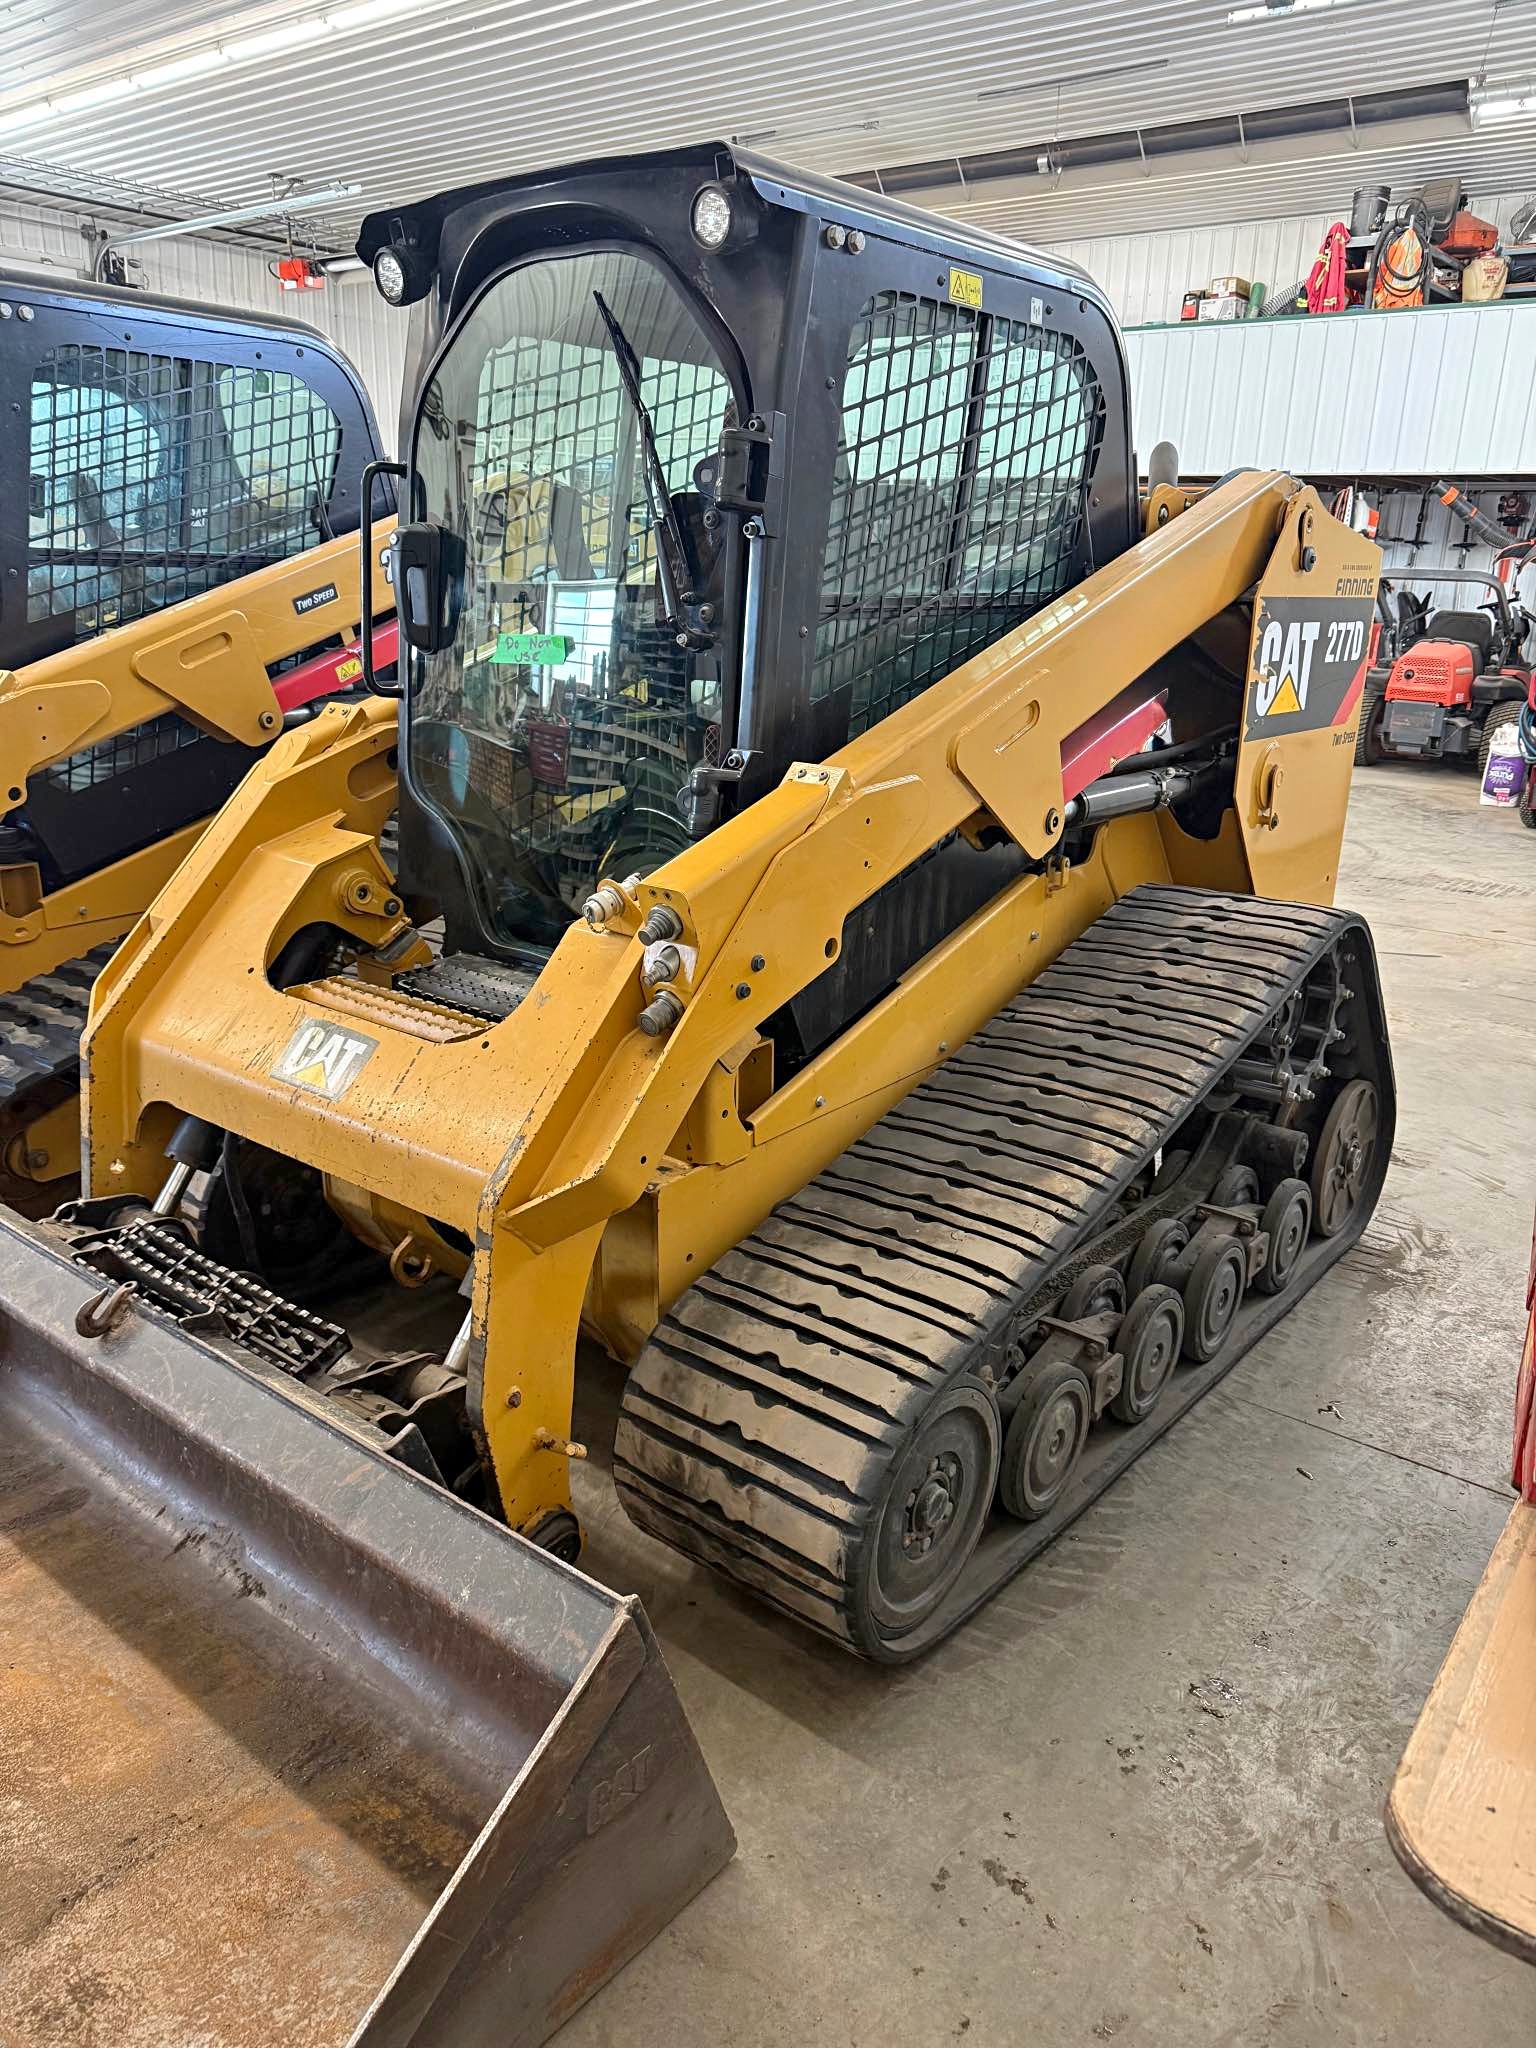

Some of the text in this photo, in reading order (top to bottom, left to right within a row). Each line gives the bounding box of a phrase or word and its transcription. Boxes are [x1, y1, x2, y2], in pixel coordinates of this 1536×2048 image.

[1336, 578, 1374, 596] FINNING
[1255, 620, 1364, 717] CAT 277D
[282, 1026, 368, 1093] CAT
